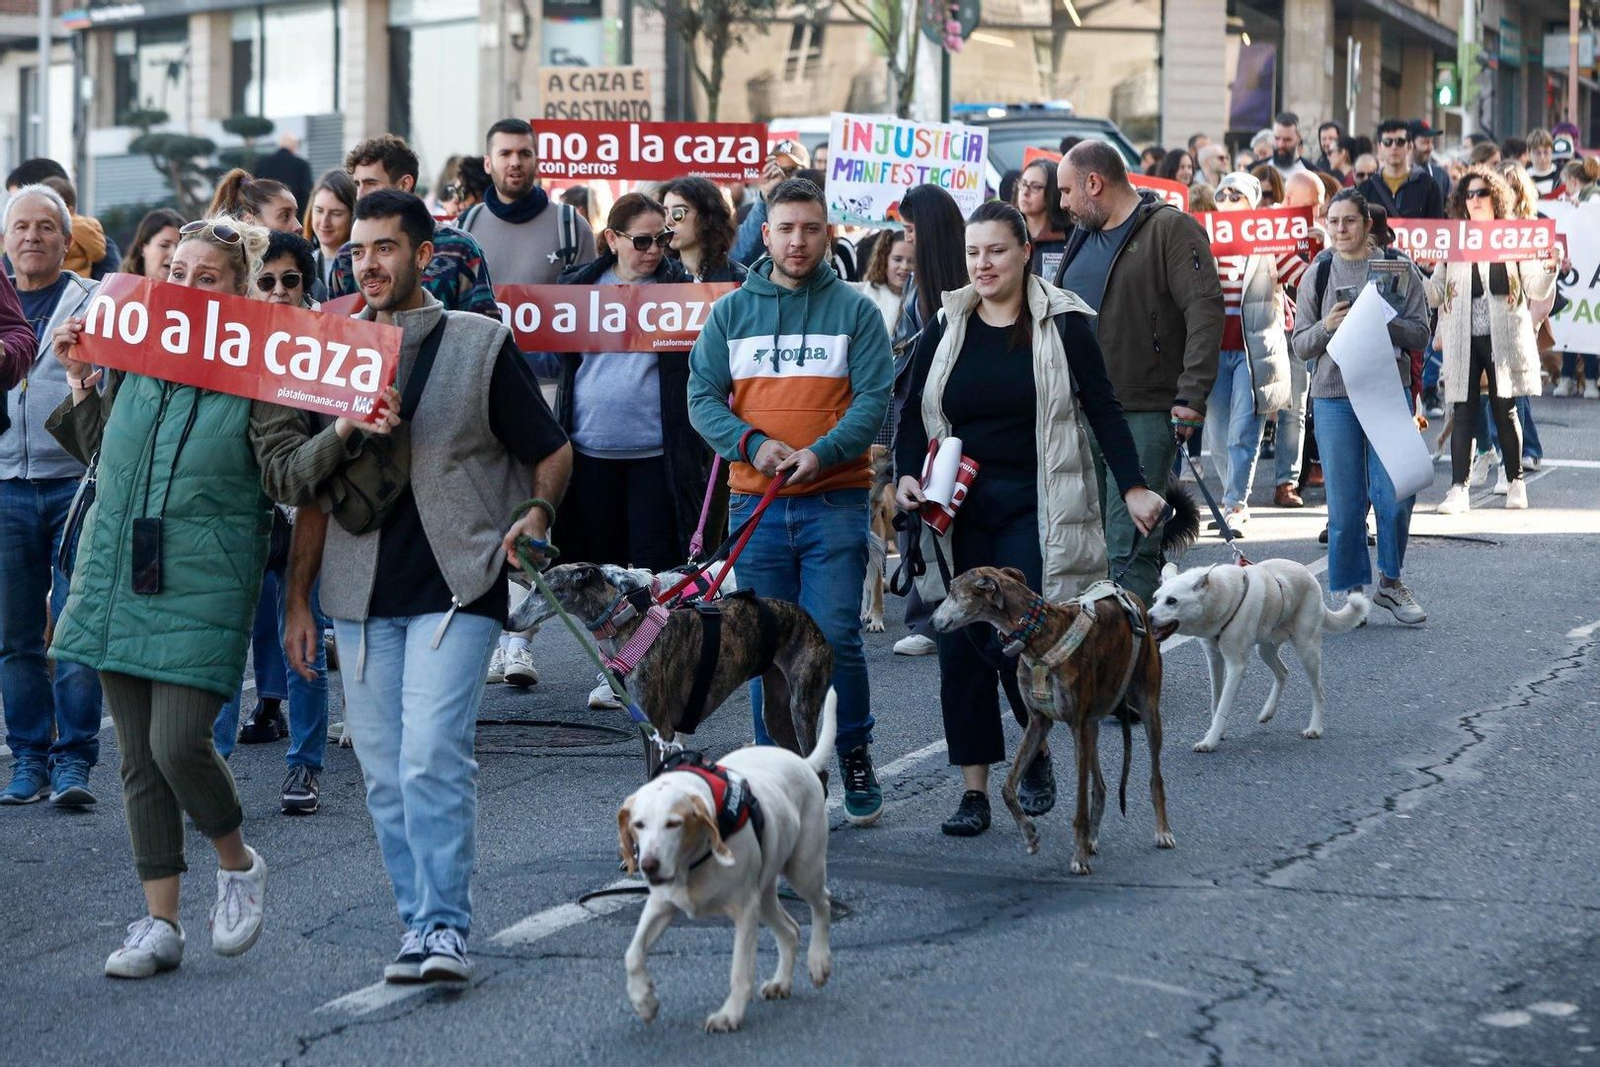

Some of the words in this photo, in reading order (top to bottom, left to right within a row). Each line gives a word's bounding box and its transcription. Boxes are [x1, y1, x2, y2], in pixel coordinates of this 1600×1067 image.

[548, 74, 563, 92] A
[569, 72, 626, 91] CAZA
[538, 132, 588, 161] no
[597, 133, 619, 162] a
[630, 123, 664, 162] la
[674, 135, 760, 164] caza
[538, 162, 565, 173] con
[568, 161, 617, 177] perros
[832, 157, 978, 190] MANIFESTACIÓN
[1204, 212, 1233, 243] la
[1240, 215, 1308, 242] caza
[1392, 227, 1427, 249] no
[1434, 227, 1451, 249] a
[1458, 221, 1483, 250] la
[1490, 226, 1549, 249] caza
[1413, 249, 1448, 261] perros
[552, 301, 577, 333] a
[589, 290, 627, 333] la
[638, 301, 715, 333] caz
[84, 294, 149, 345] no
[160, 309, 191, 355] a
[203, 300, 251, 367] la
[264, 331, 383, 393] caza
[277, 387, 349, 412] plataformanac.org
[352, 394, 374, 415] NAC
